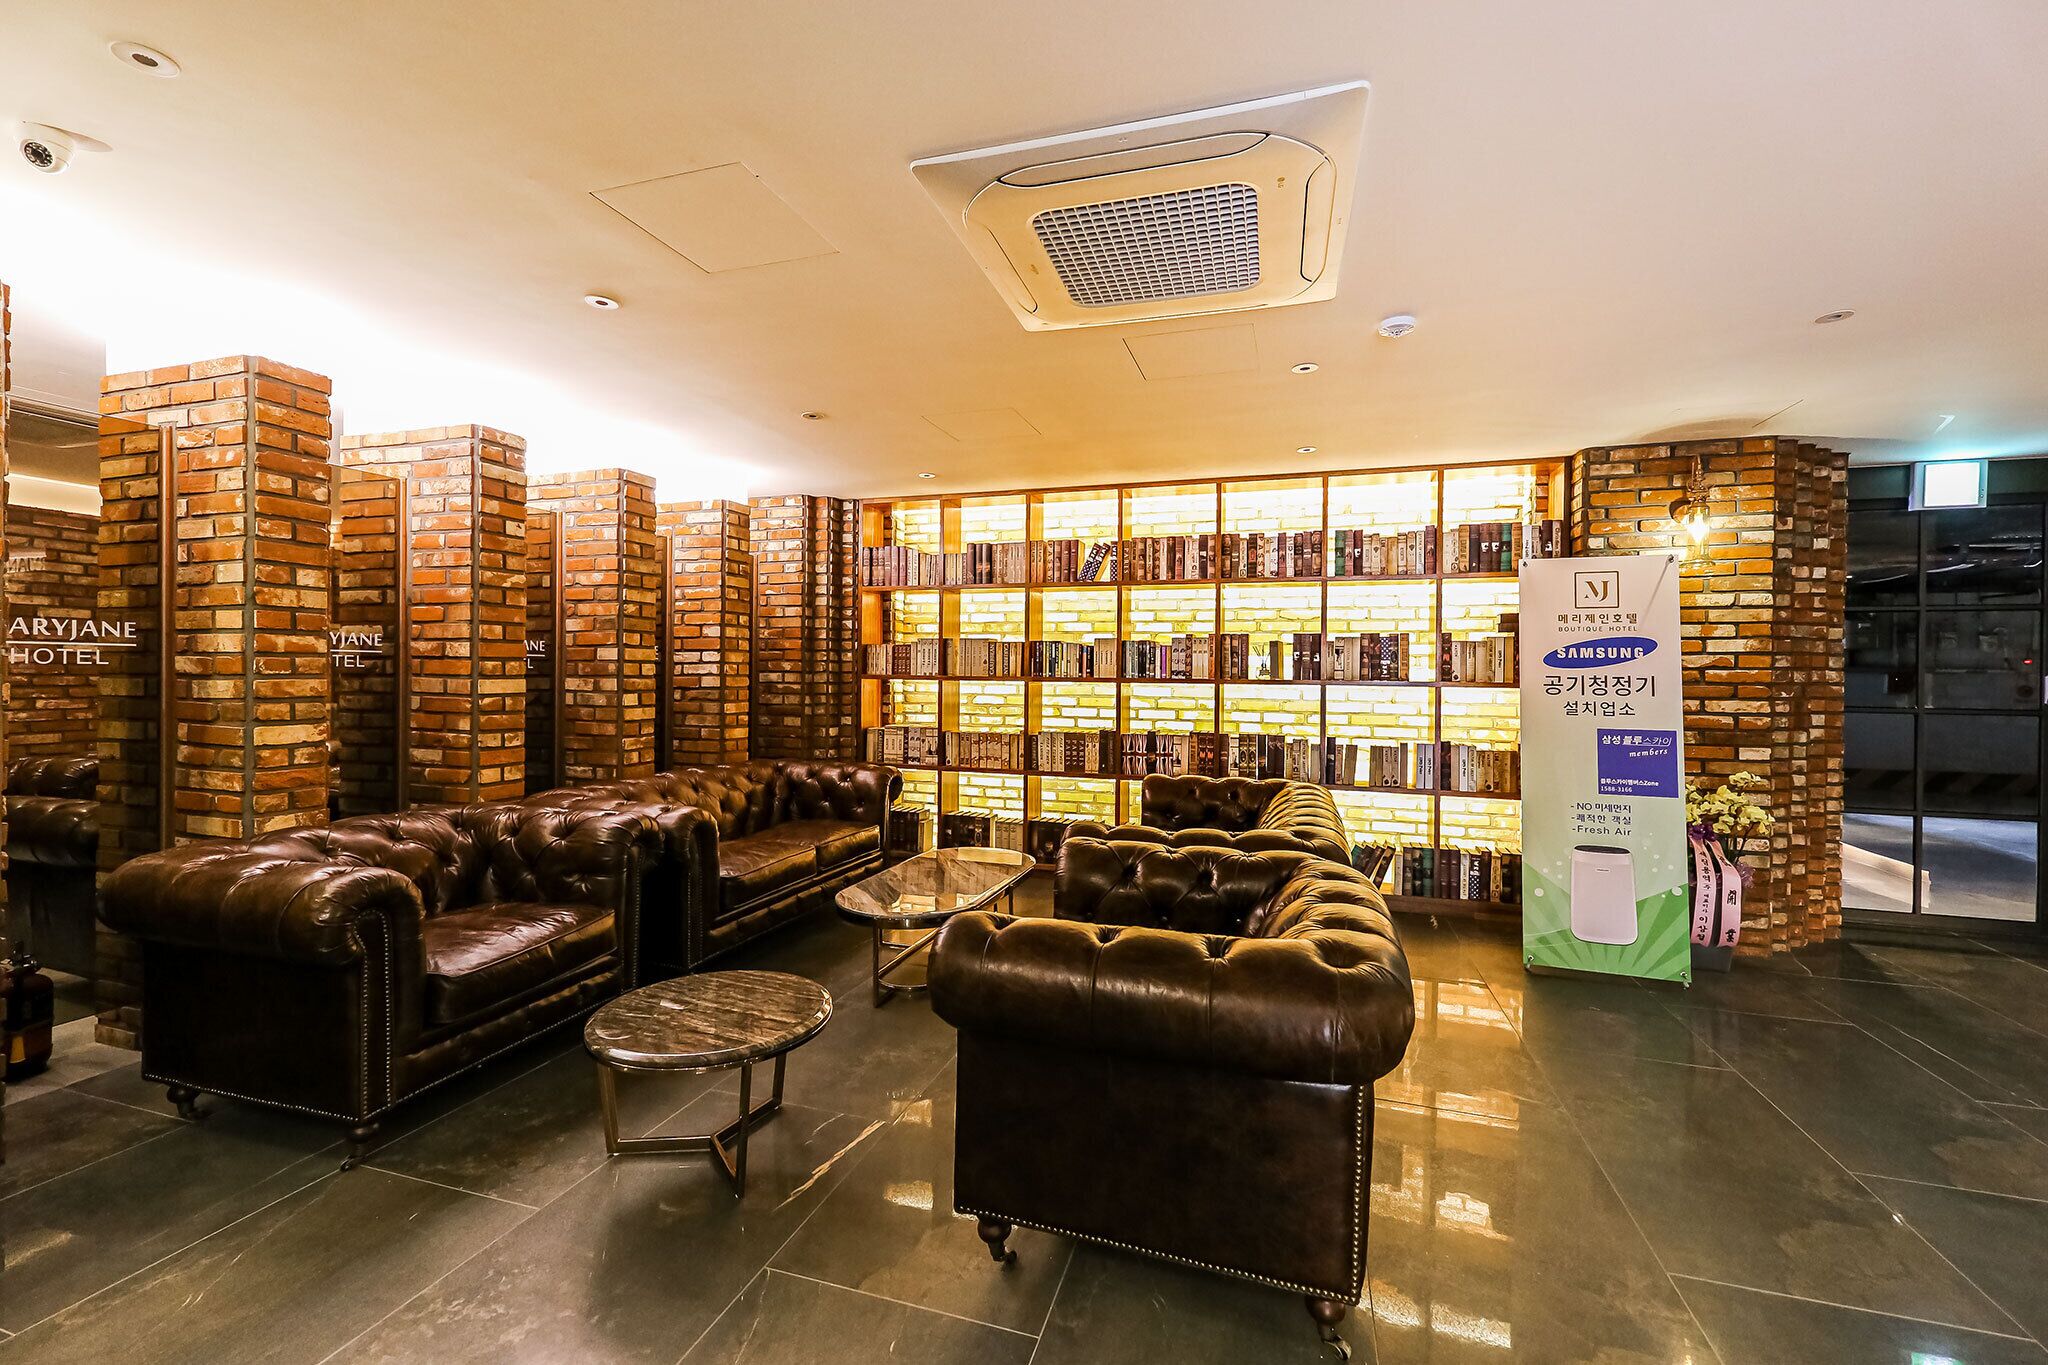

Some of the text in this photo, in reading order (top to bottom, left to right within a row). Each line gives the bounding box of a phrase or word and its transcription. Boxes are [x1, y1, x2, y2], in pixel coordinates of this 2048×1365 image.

[1557, 613, 1638, 624] 메리제인호텔
[8, 617, 137, 641] ARYJANE
[1608, 625, 1638, 633] HOTEL
[329, 631, 383, 649] YJANE
[10, 647, 110, 665] HOTEL
[1556, 647, 1645, 659] SAMSUNG
[332, 654, 365, 668] TEL
[1543, 675, 1656, 697] 공기청정기
[1563, 701, 1636, 717] 설치업소
[1602, 735, 1621, 745] 삼성
[1629, 748, 1668, 757] members
[1594, 803, 1632, 814] 미세먼지
[1611, 815, 1631, 826] 객실
[1614, 827, 1632, 836] Air
